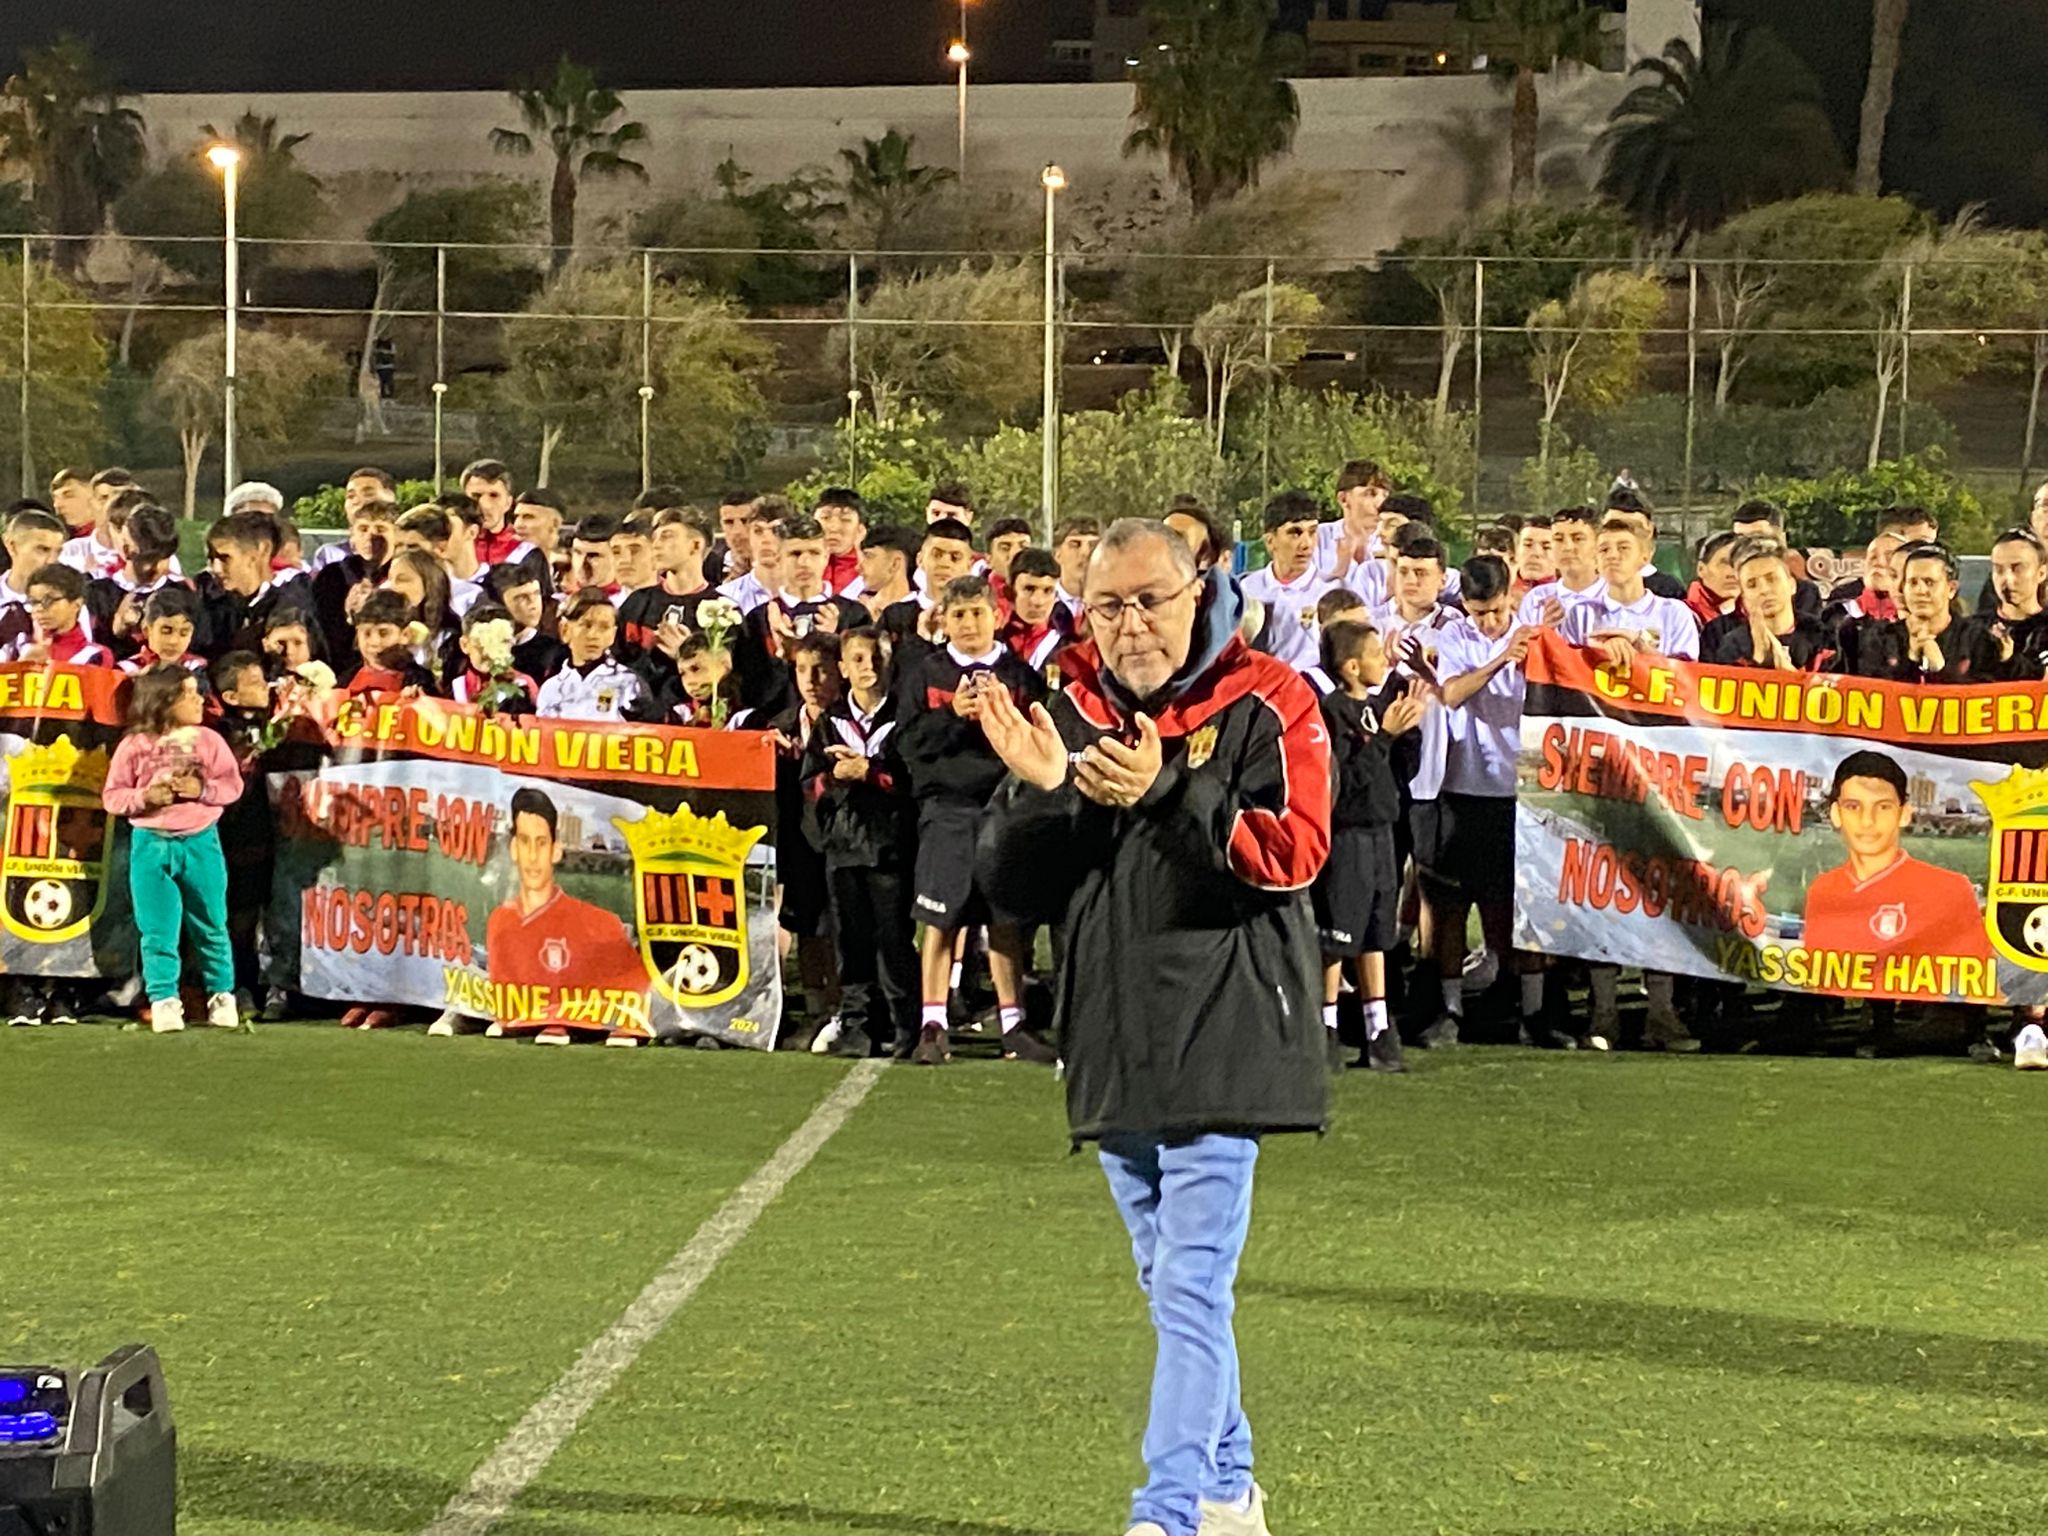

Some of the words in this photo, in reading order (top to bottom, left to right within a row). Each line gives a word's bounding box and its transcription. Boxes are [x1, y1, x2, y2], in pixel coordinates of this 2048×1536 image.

[1594, 667, 1685, 706] C.F.
[554, 730, 700, 777] VIERA
[1538, 723, 1709, 820] SIEMPRE
[1722, 762, 1805, 835] CON
[437, 794, 495, 866] CON
[1558, 838, 1767, 938] NOSOTROS
[2021, 888, 2048, 898] UNI
[303, 887, 473, 966] NOSOTROS
[443, 967, 550, 1021] YASSINE
[556, 987, 652, 1030] HATRI
[1715, 936, 1877, 991] YASSINE
[1883, 954, 1998, 998] HATRI
